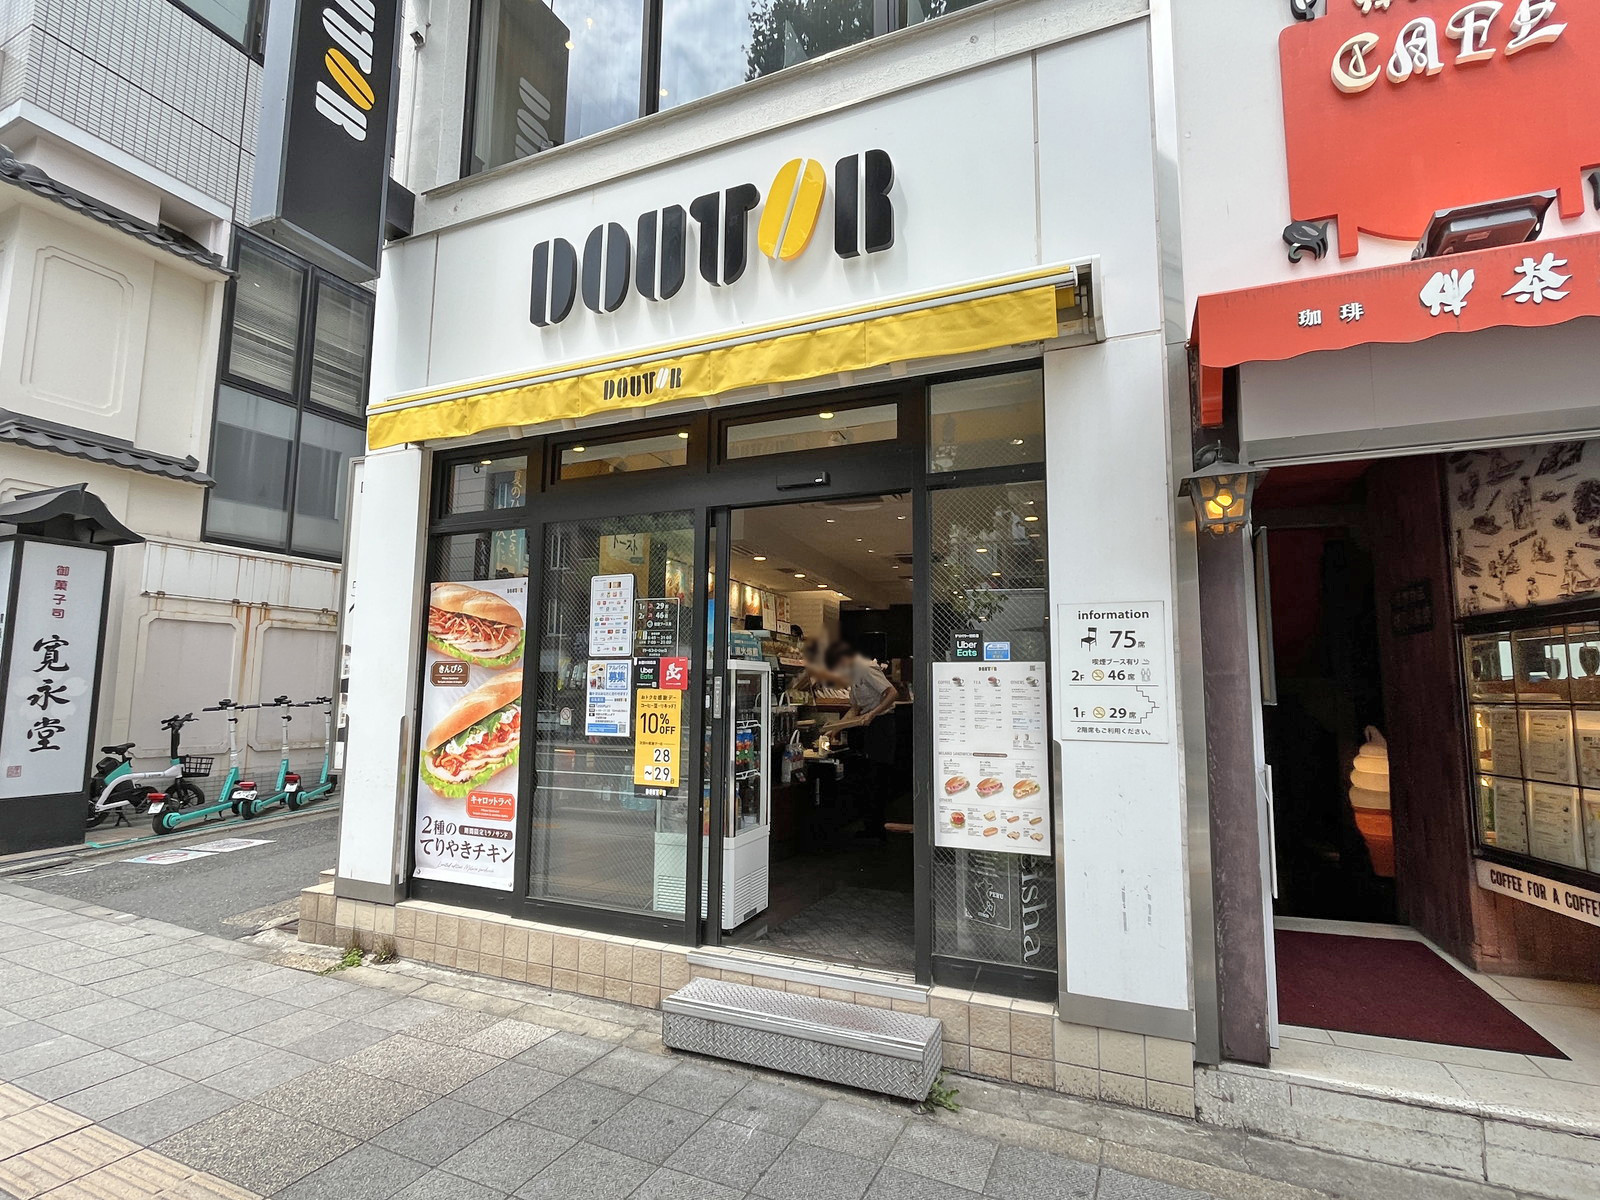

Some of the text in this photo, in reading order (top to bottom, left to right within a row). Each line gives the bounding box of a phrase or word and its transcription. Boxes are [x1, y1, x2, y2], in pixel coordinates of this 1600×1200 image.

[1331, 0, 1568, 93] CAFE
[529, 148, 895, 328] DOUTOR
[1298, 302, 1364, 328] 珈琲
[603, 367, 682, 401] DOUTOR
[52, 565, 70, 619] 御菓子司
[1078, 609, 1150, 620] information
[956, 640, 977, 649] Uber
[956, 649, 978, 657] Eats
[1092, 658, 1139, 666] 喫煙ブース有り
[438, 664, 463, 674] きんぴら
[1071, 670, 1085, 681] 2F
[609, 671, 626, 683] 募集
[1073, 706, 1086, 718] 1F
[640, 712, 676, 735] 10% OFF
[1077, 726, 1151, 736] 2階席もご利用ください。
[654, 748, 670, 763] 28
[421, 815, 457, 835] 2種の
[419, 838, 514, 864] てりやきチキン
[1490, 868, 1524, 893] COFFEE
[1527, 880, 1548, 901] FOR
[1552, 887, 1561, 905] A
[989, 890, 1004, 900] PERU
